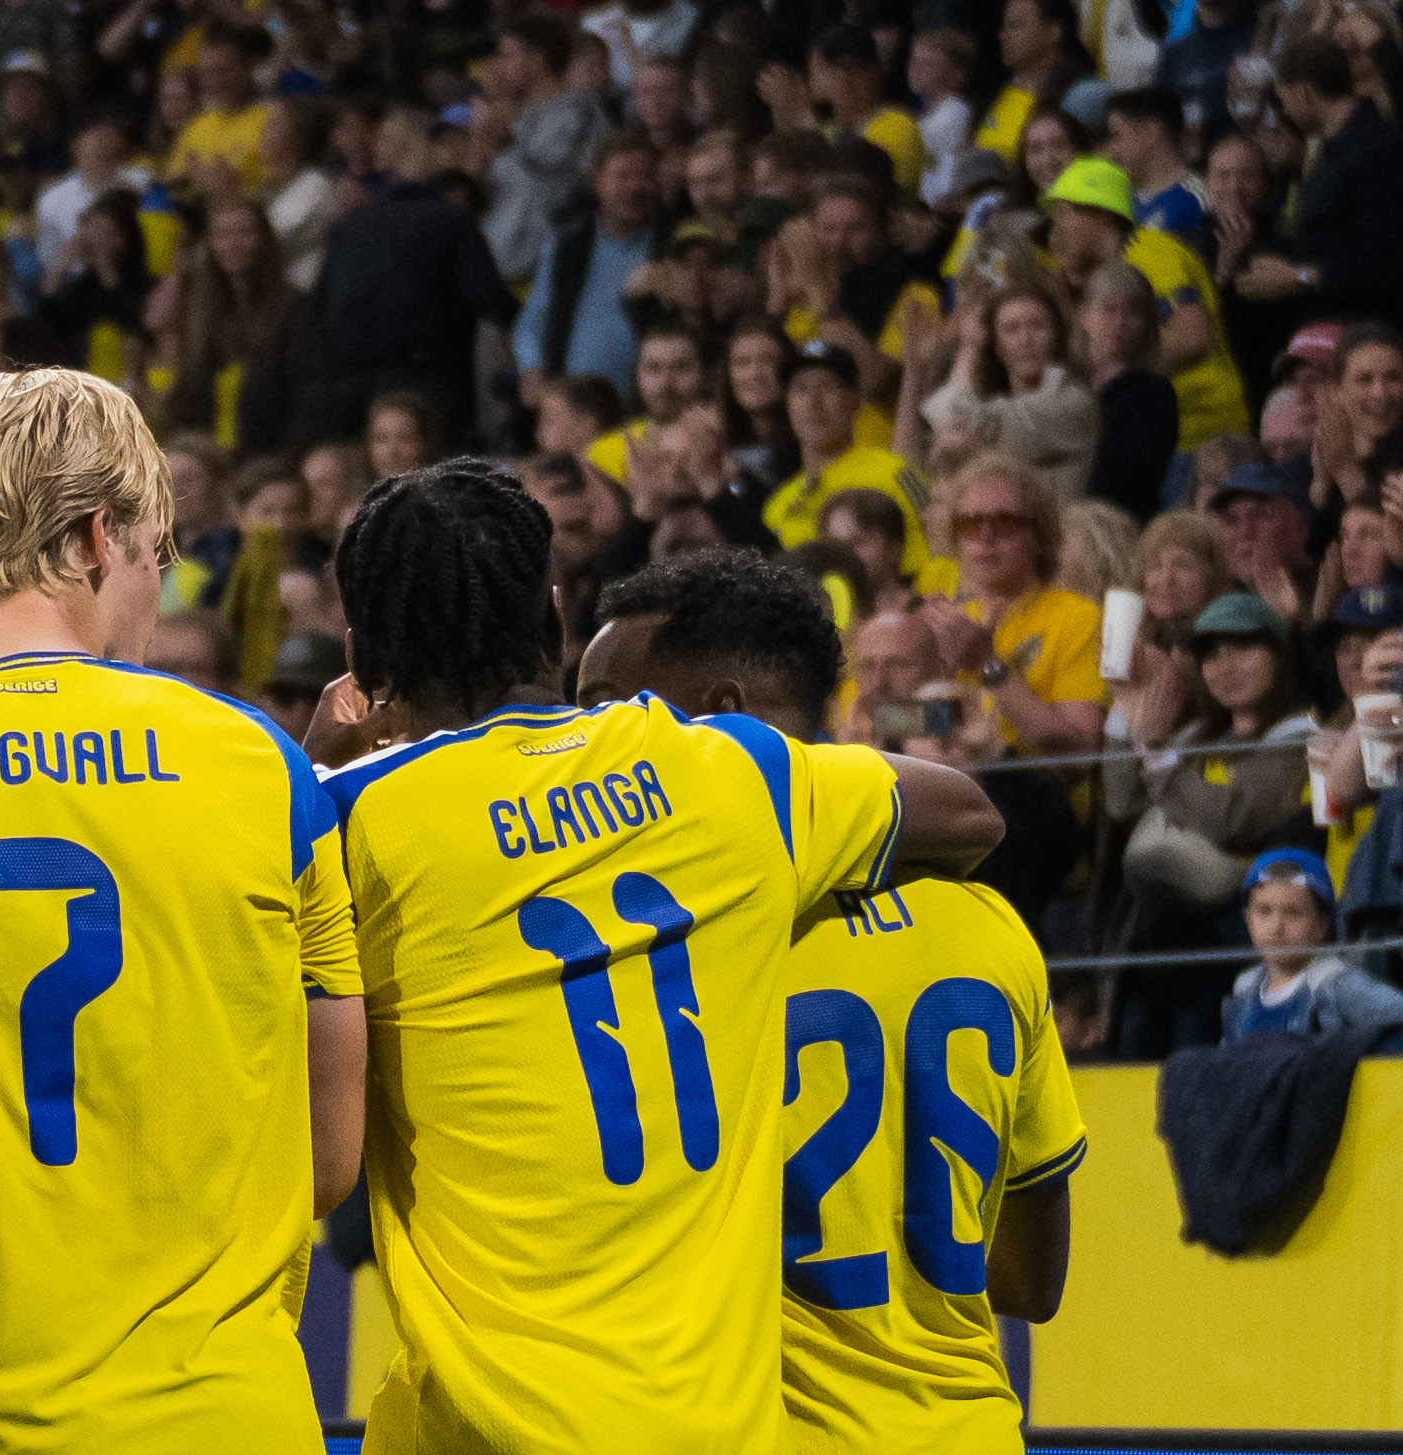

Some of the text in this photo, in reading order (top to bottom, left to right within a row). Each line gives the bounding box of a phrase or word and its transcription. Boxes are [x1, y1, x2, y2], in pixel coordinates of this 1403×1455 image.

[488, 759, 673, 860] ELANGA
[517, 871, 721, 1186] 11
[782, 976, 1016, 1311] 26
